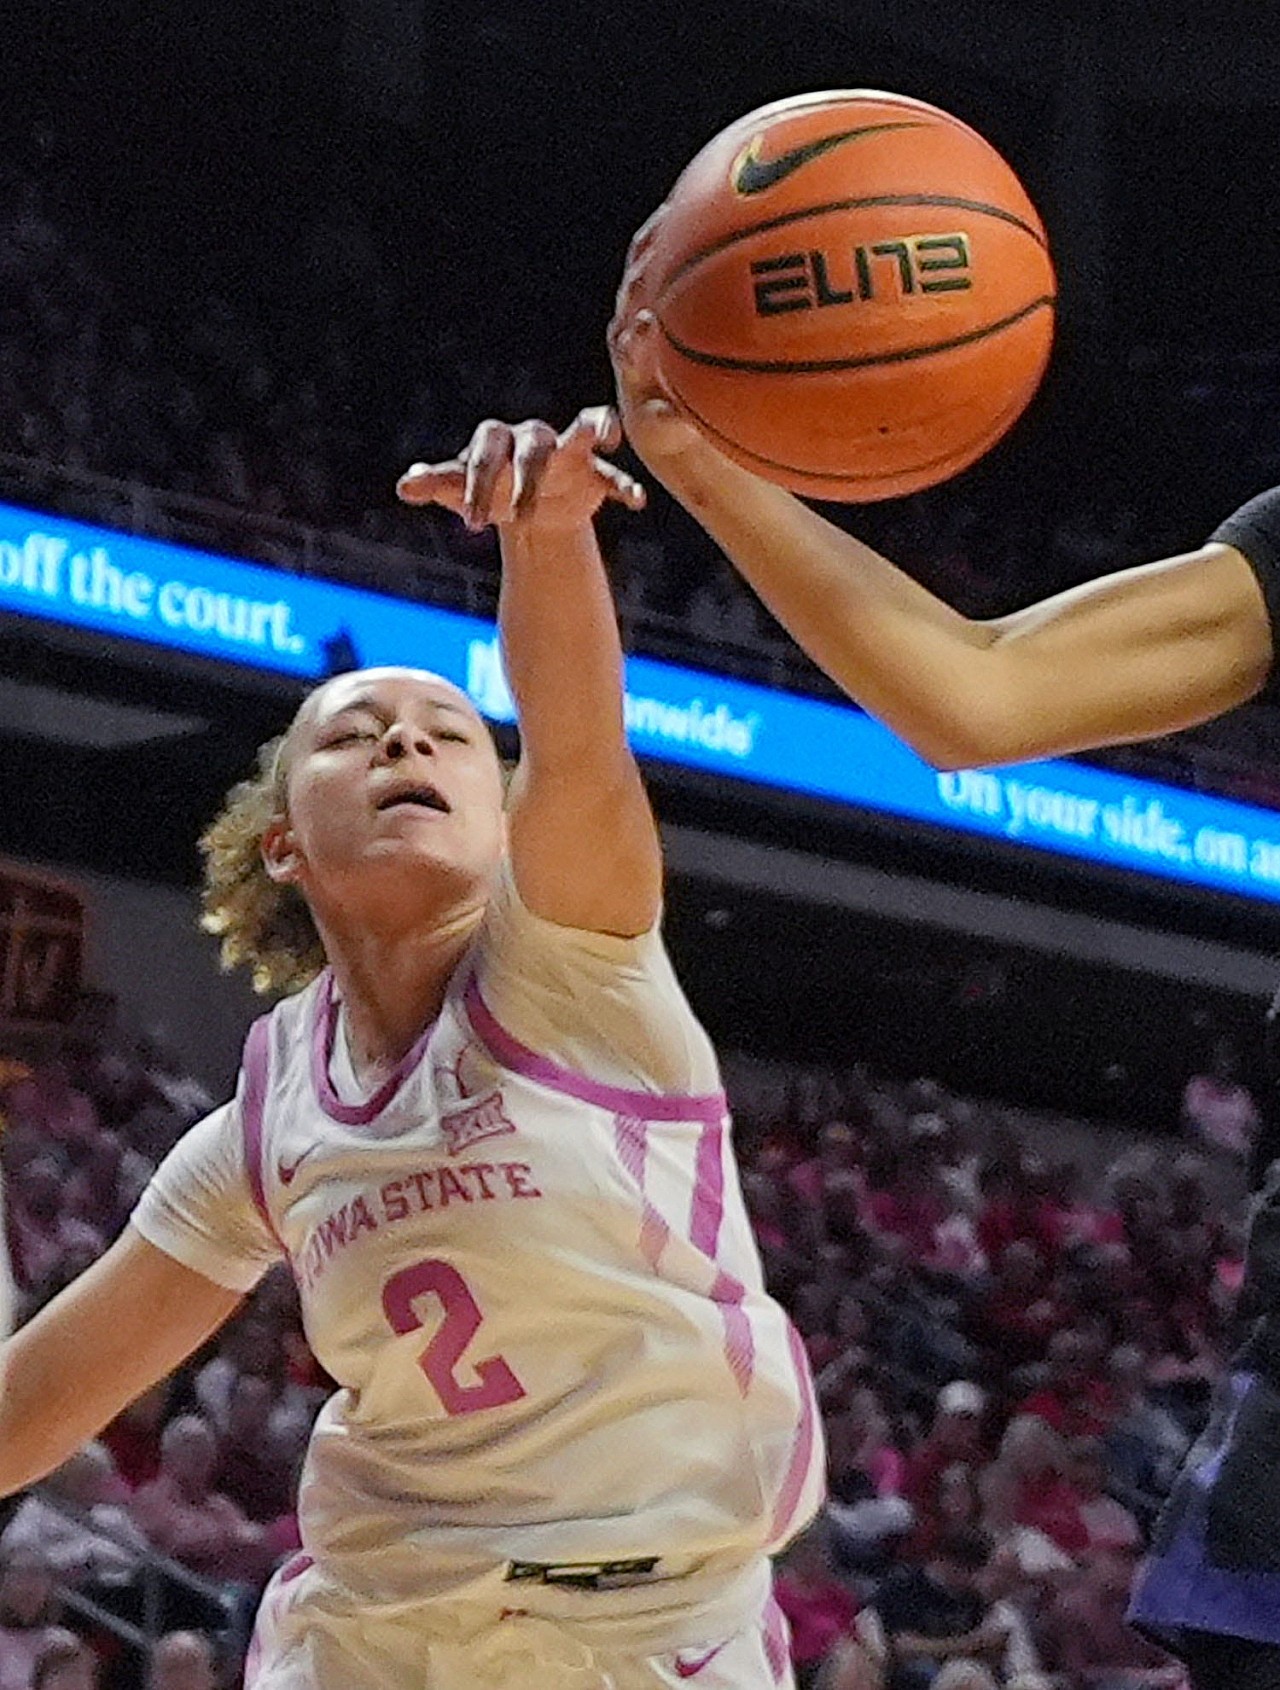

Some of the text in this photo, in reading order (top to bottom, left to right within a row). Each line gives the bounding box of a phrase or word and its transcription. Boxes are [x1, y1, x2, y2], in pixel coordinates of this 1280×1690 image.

[749, 230, 972, 319] ELITE
[0, 532, 306, 654] off the court.
[1004, 778, 1099, 838] your
[379, 1161, 543, 1223] STATE
[380, 1256, 527, 1417] 2
